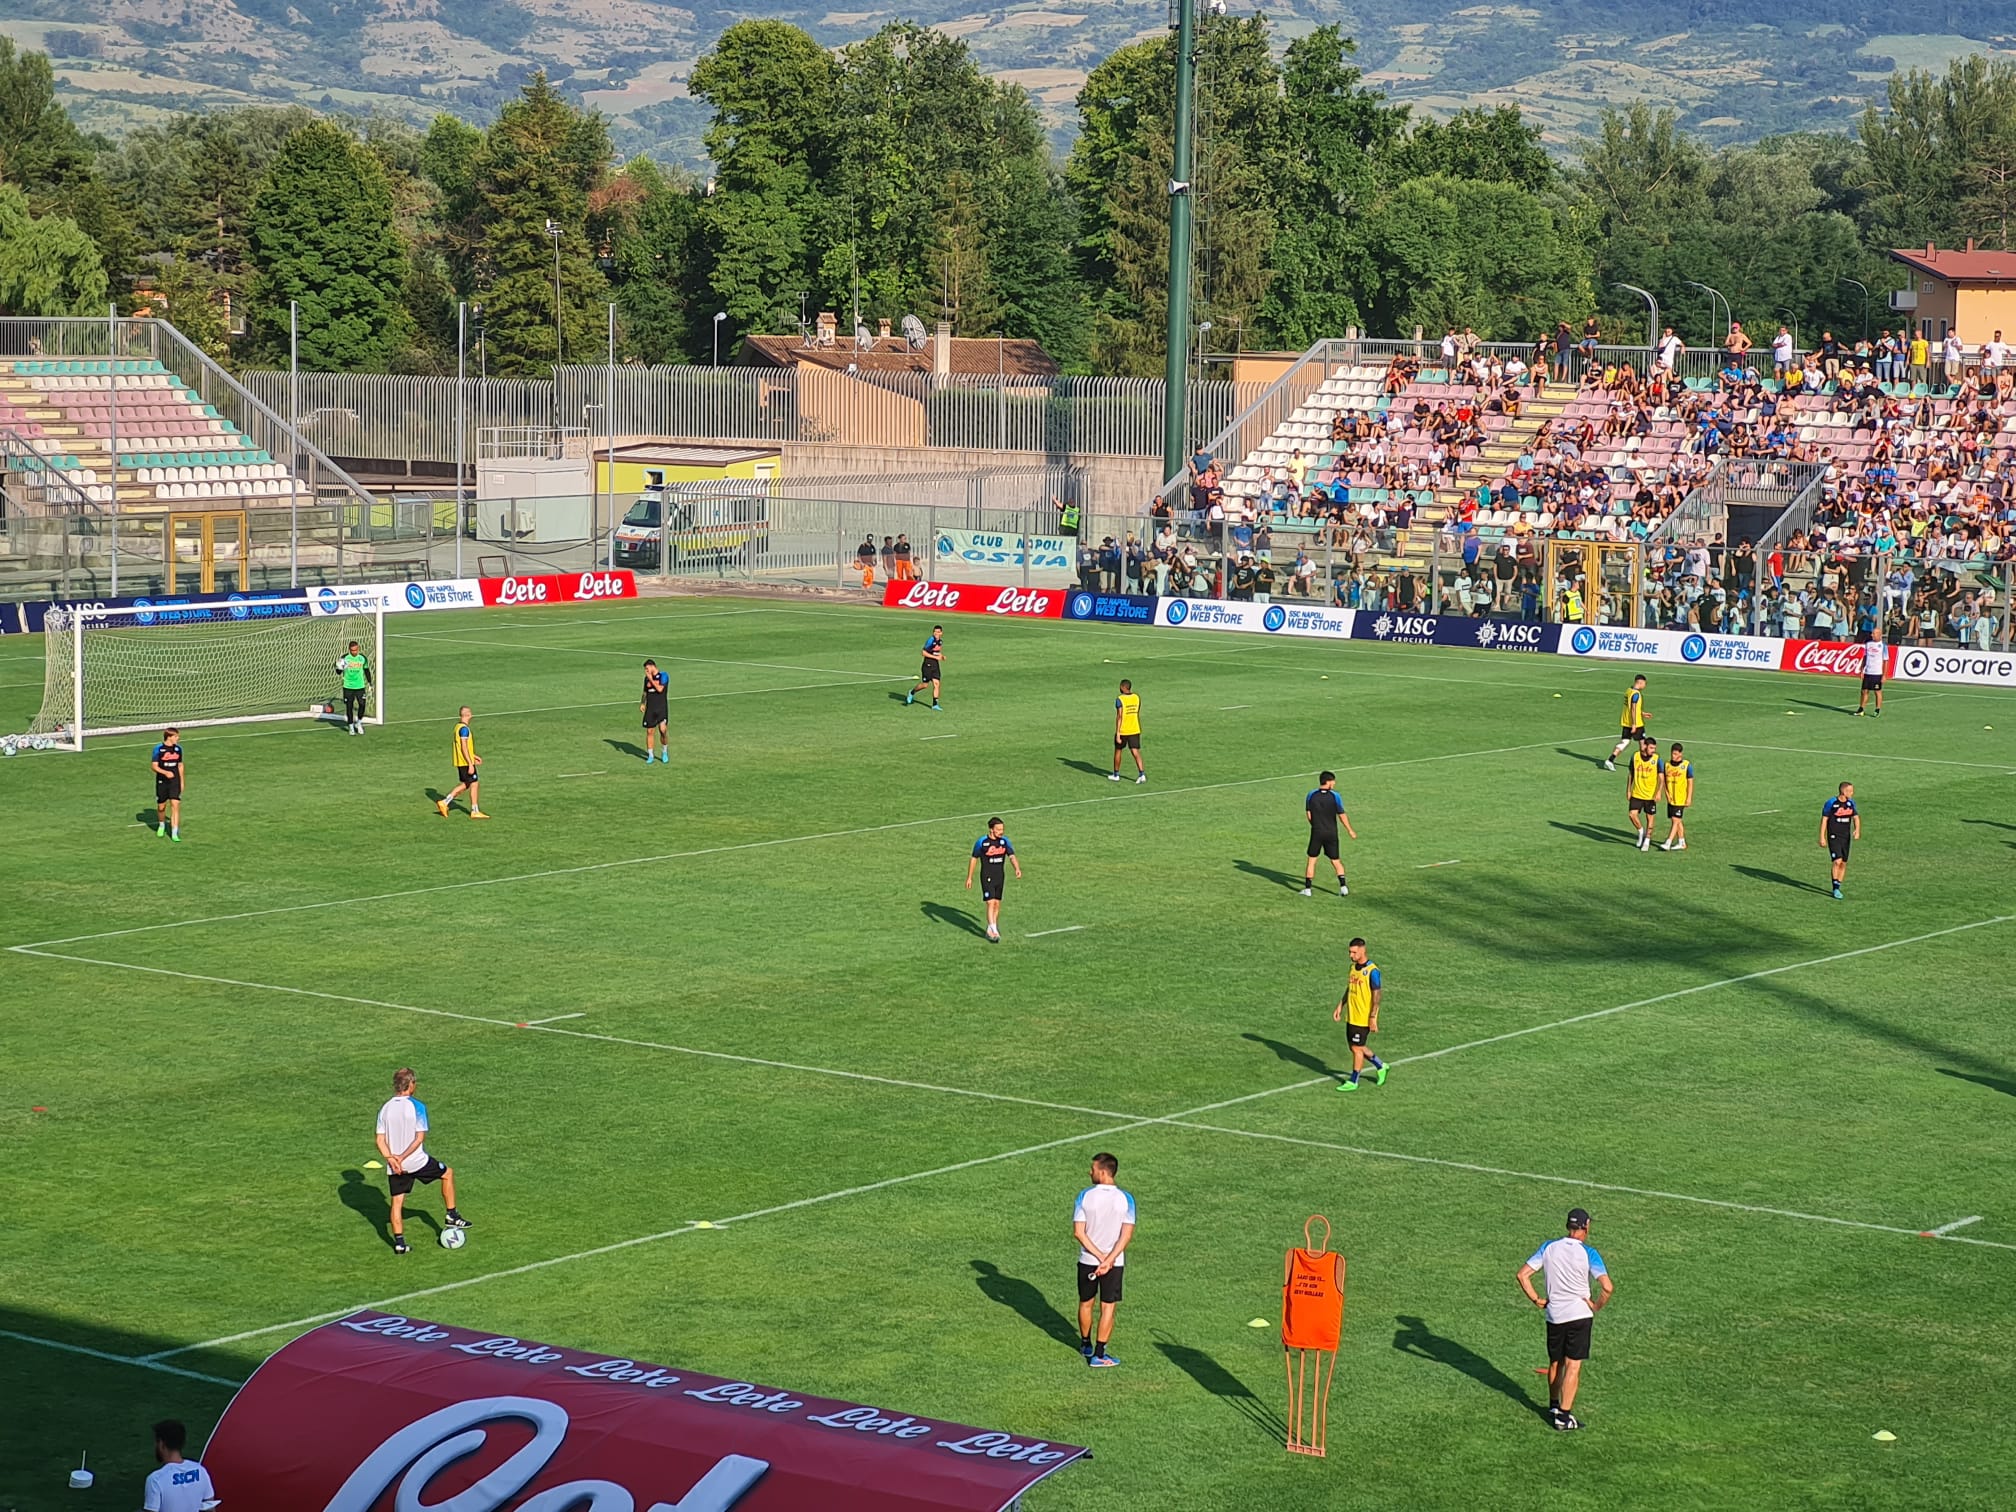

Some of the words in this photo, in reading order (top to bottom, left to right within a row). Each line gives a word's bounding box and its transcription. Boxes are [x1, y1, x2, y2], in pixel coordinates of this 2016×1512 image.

[972, 534, 1003, 547] CLUB
[963, 549, 1067, 567] OSTIA
[495, 577, 547, 605] Lete
[573, 572, 623, 600] Lete
[898, 581, 960, 608] Lete
[427, 593, 446, 603] WEB
[448, 591, 474, 602] STORE
[986, 587, 1048, 614] Lete
[1096, 597, 1108, 605] SSC
[1108, 598, 1130, 606] NAPOLI
[1095, 605, 1115, 616] WEB
[1118, 606, 1149, 619] STORE
[1190, 610, 1210, 622] WEB
[1213, 612, 1244, 625] STORE
[1191, 603, 1203, 611] SSC
[1204, 605, 1225, 613] NAPOLI
[1301, 611, 1324, 619] NAPOLI
[1287, 617, 1308, 629] WEB
[1311, 619, 1343, 632] STORE
[1393, 616, 1437, 636] MSC
[1498, 623, 1542, 644] MSC
[1600, 631, 1612, 639] SSC
[1613, 632, 1637, 641] NAPOLI
[1710, 639, 1722, 647] SSC
[1723, 640, 1749, 649] NAPOLI
[1598, 639, 1621, 651] WEB
[1624, 641, 1659, 654] STORE
[1708, 647, 1732, 659] WEB
[1736, 649, 1771, 662] STORE
[1795, 641, 1864, 674] Coca-Col
[1934, 656, 2013, 677] sorare
[340, 1315, 450, 1343] Lete
[450, 1337, 563, 1365] Lete
[564, 1359, 680, 1388] Lete
[683, 1382, 804, 1413] Lete
[806, 1407, 931, 1438] Lete
[936, 1432, 1065, 1465] Lete
[172, 1469, 200, 1485] SSCN
